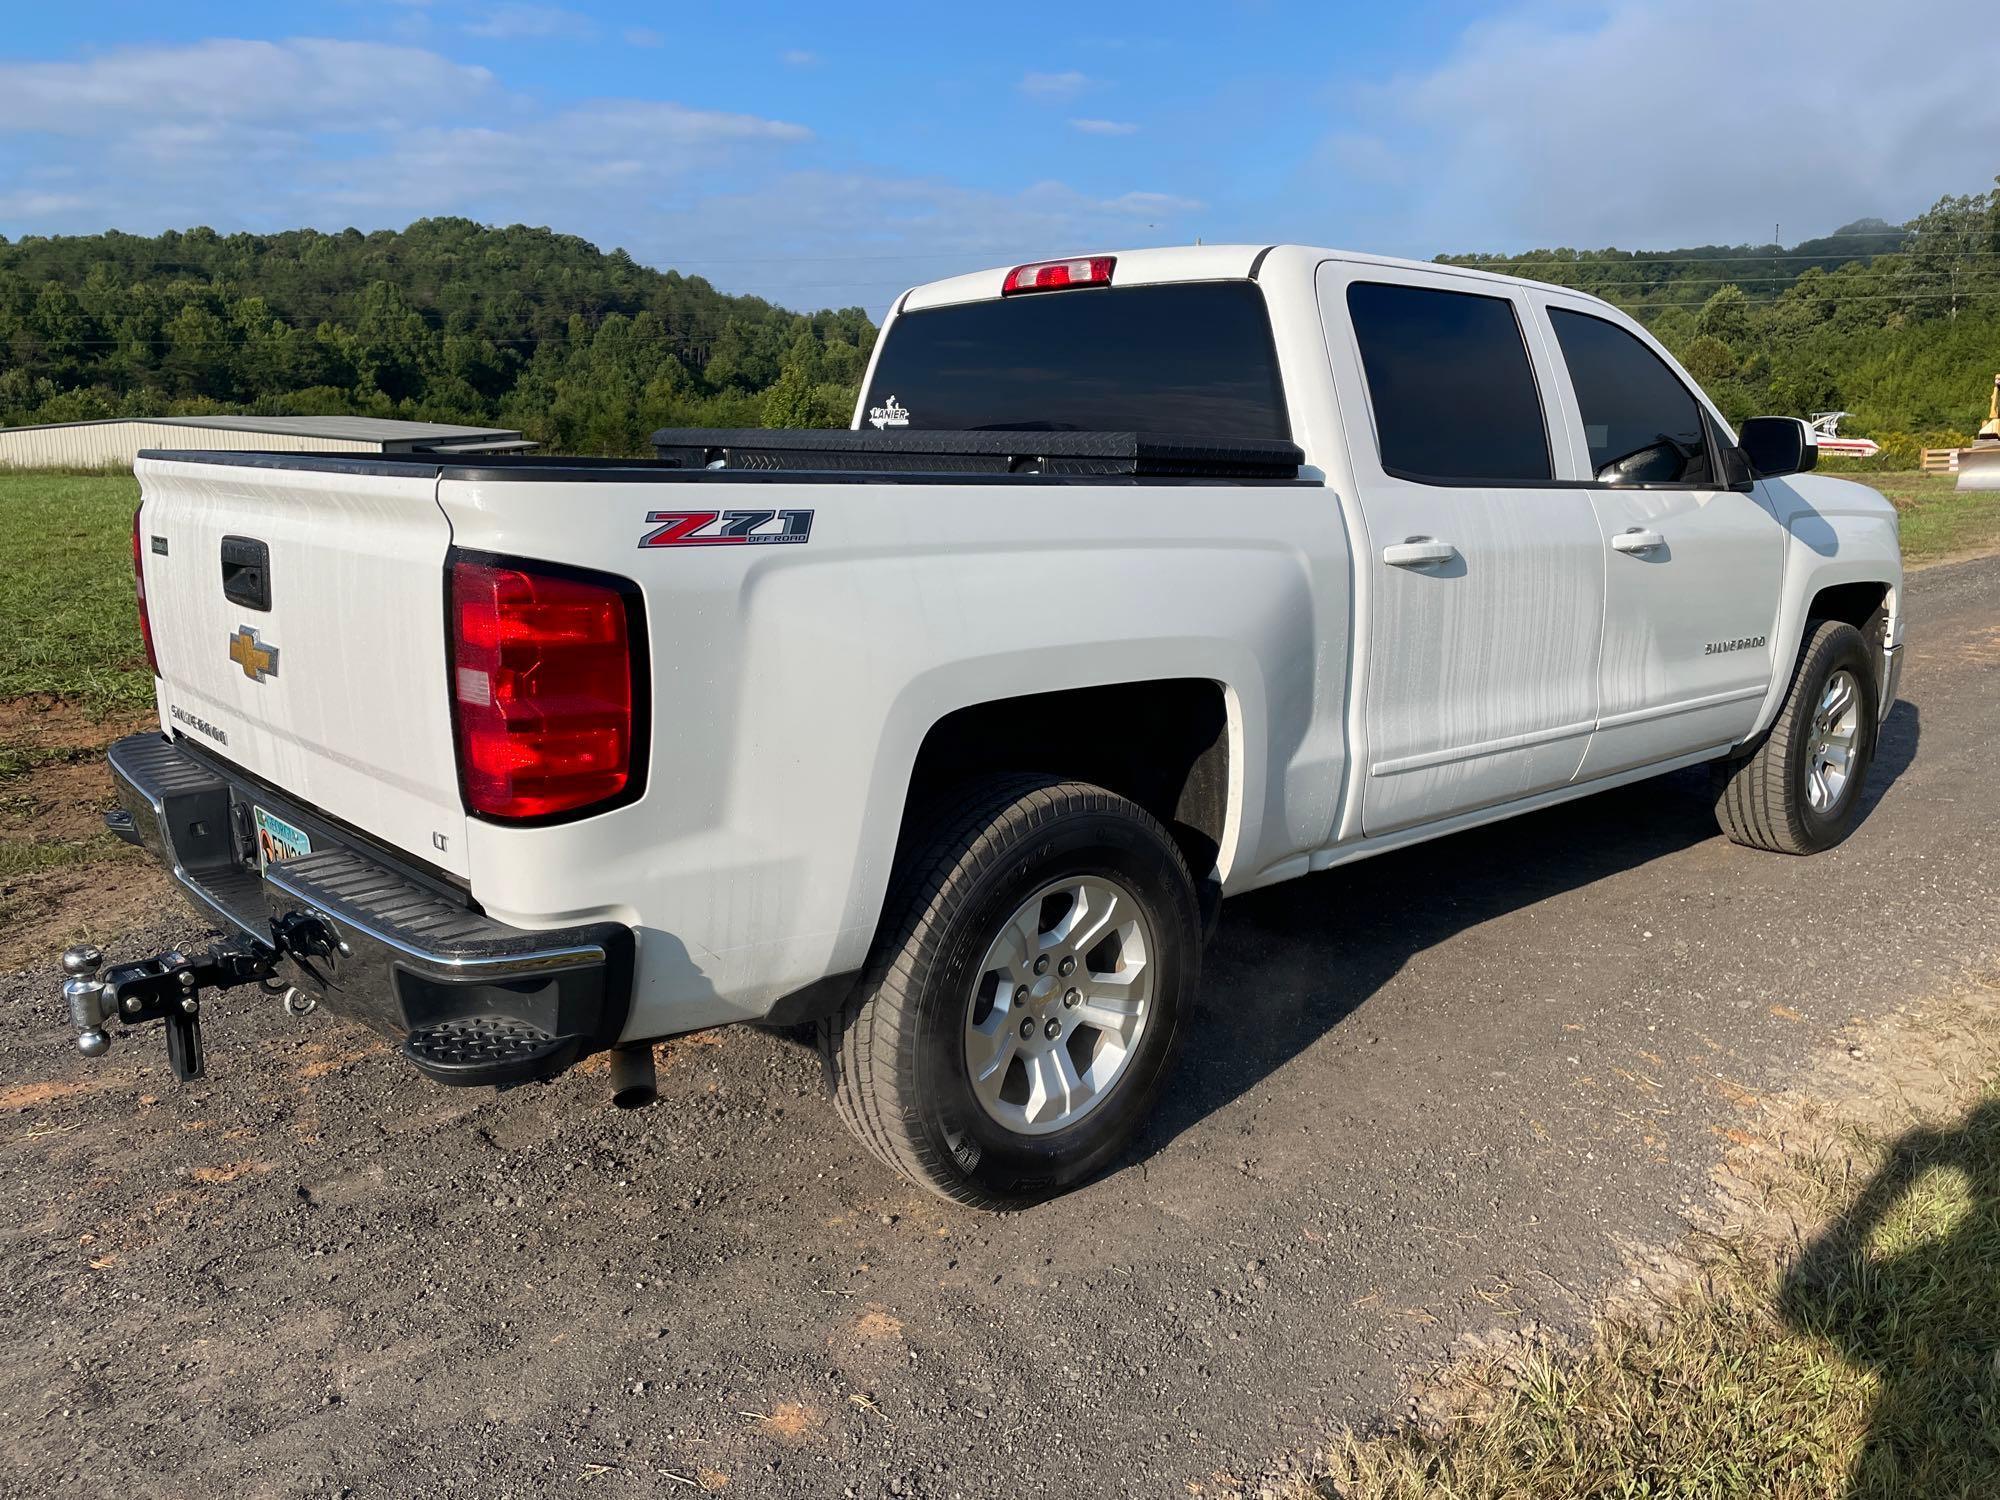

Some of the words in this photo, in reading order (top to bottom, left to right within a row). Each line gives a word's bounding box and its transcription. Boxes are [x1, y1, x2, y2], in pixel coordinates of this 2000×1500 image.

[872, 408, 906, 419] LANIER
[637, 509, 815, 549] Z71
[748, 534, 772, 543] OFF
[773, 534, 807, 542] ROAD
[1703, 635, 1766, 656] SILVERADO
